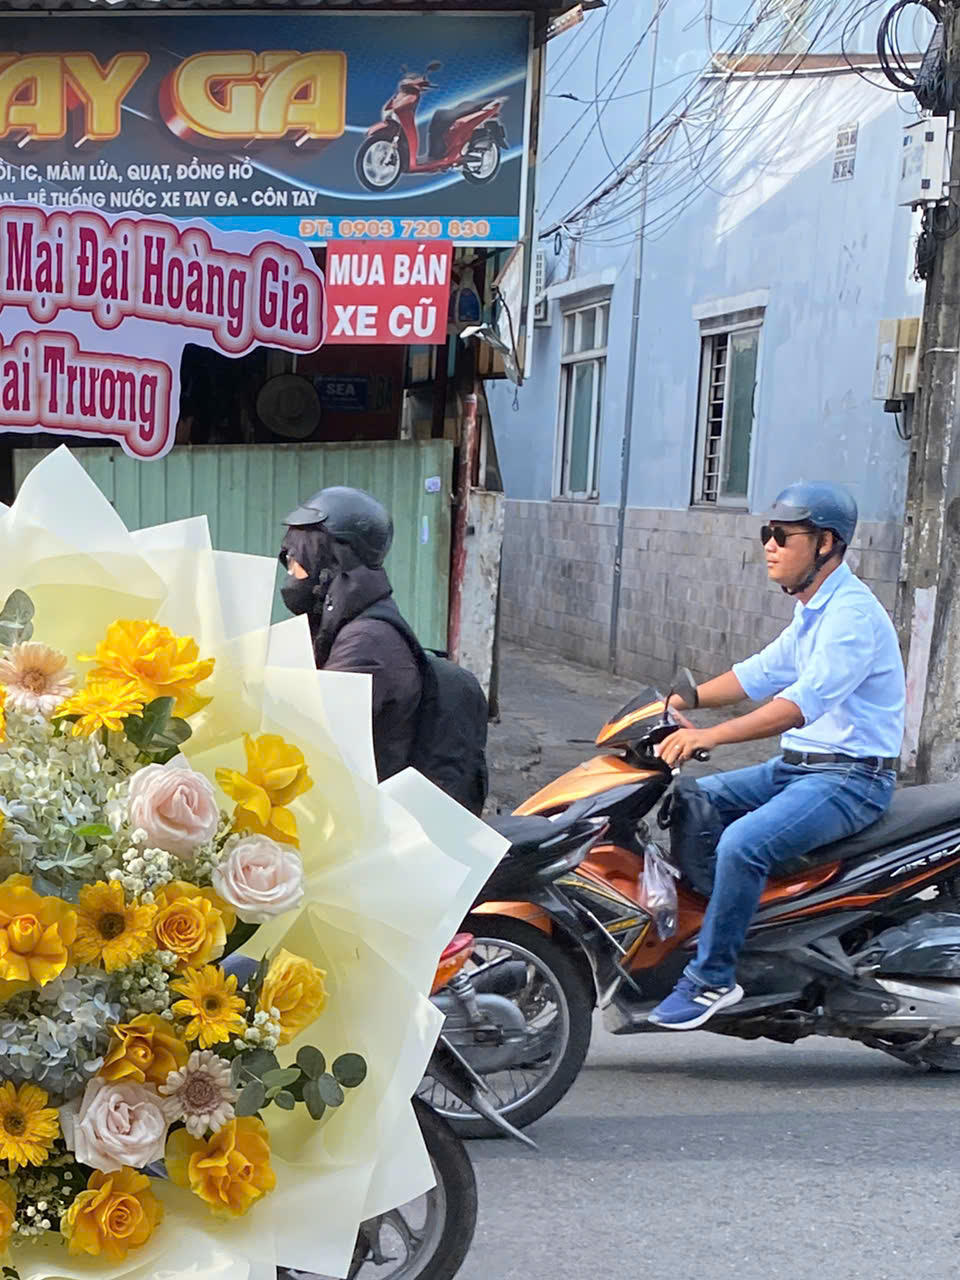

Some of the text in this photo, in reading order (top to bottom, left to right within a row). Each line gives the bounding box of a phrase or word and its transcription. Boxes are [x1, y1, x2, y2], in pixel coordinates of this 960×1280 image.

[168, 50, 348, 148] GA
[20, 164, 43, 184] IC,
[46, 162, 85, 182] MÂM
[90, 159, 123, 183] LỬA,
[127, 164, 172, 185] QUẠT,
[176, 157, 225, 181] ĐỒNG
[229, 156, 253, 180] HỒ
[50, 186, 106, 208] THỐNG
[110, 187, 157, 208] NƯỚC
[161, 191, 180, 208] XE
[184, 191, 211, 208] TAY
[214, 191, 239, 207] GA
[251, 187, 288, 207] CÔN
[291, 190, 318, 207] TAY
[299, 219, 490, 237] ĐT: 0903 720 830
[6, 221, 64, 308] Mại
[76, 227, 129, 315] Đại
[142, 235, 247, 338] Hoàng
[259, 257, 309, 336] Gia
[329, 244, 448, 286] MUA BÁN
[331, 297, 437, 337] XE CŨ
[43, 346, 158, 442] Trương
